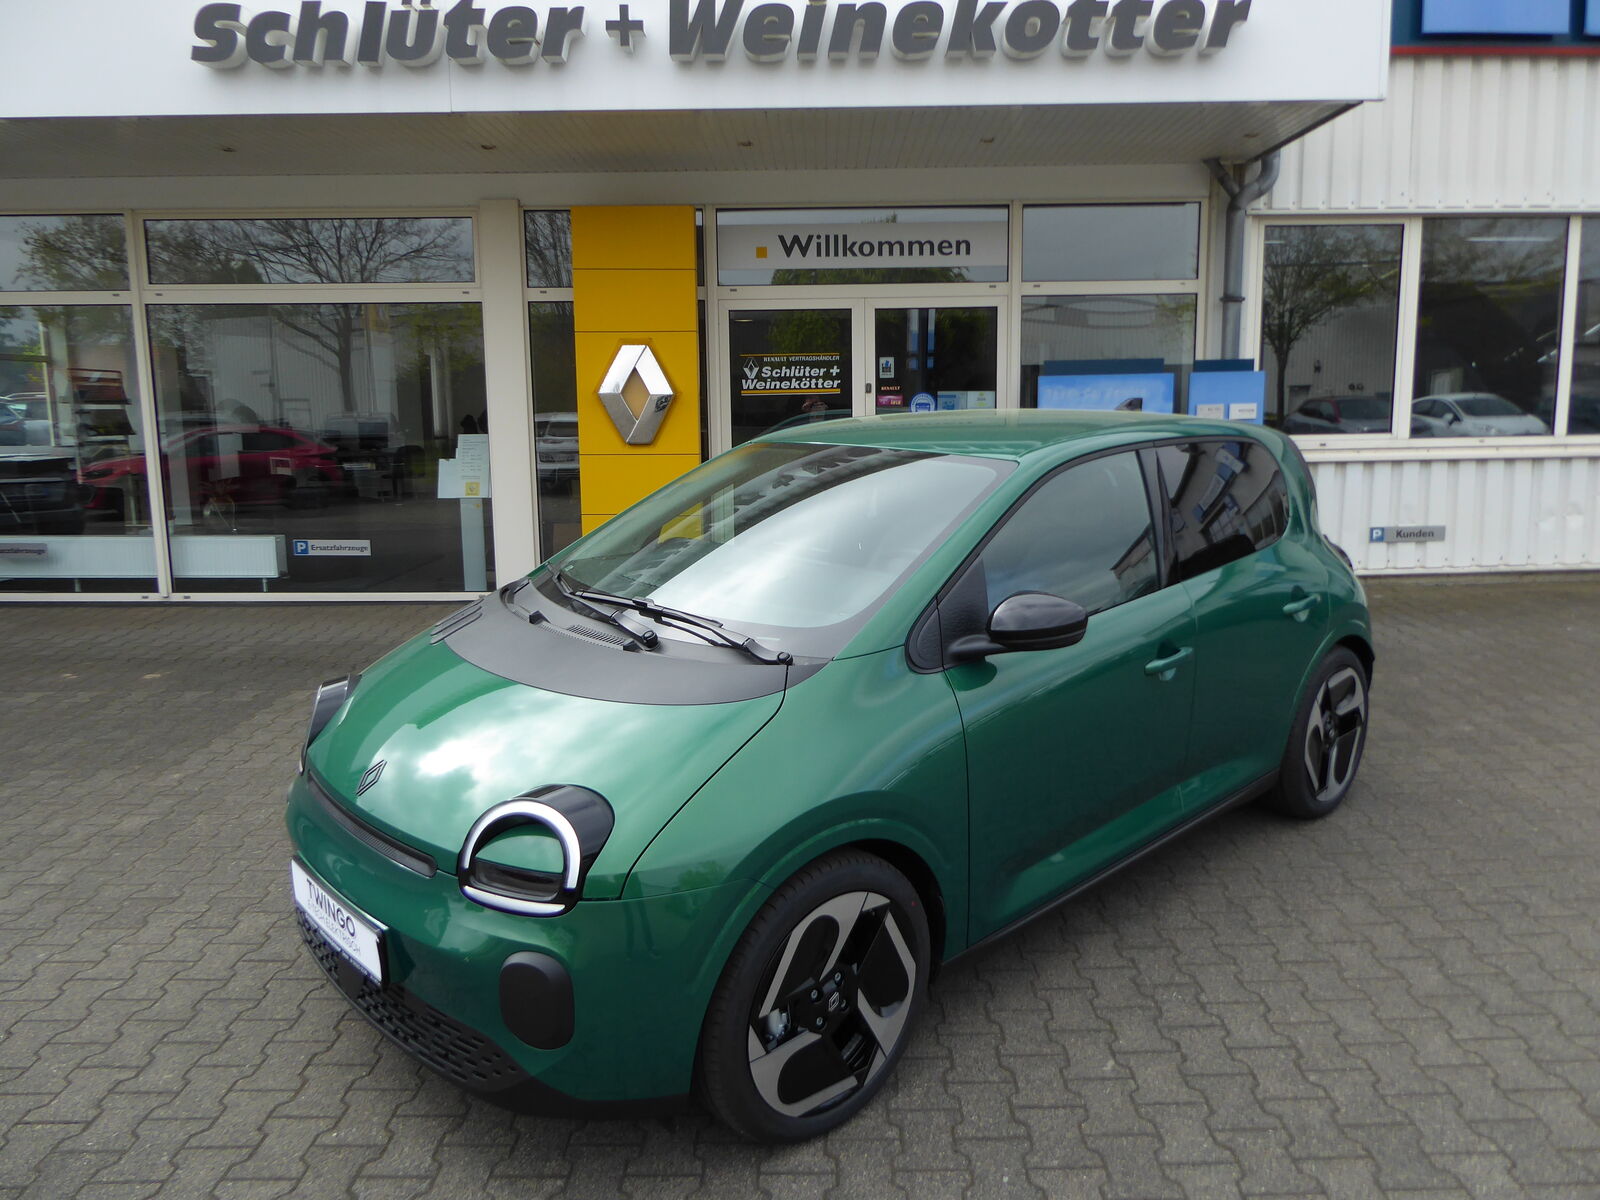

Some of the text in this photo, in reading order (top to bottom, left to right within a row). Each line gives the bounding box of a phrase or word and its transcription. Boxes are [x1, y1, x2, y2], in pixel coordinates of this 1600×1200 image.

[191, 0, 587, 66] Schlüter
[605, 4, 646, 50] +
[778, 234, 971, 258] Willkommen
[761, 365, 841, 378] Schlüter +
[741, 379, 841, 390] Weinekötter
[1372, 529, 1434, 540] P Kunden
[296, 542, 369, 553] P Ersatzfahrzeuge
[306, 877, 356, 937] TWINGO
